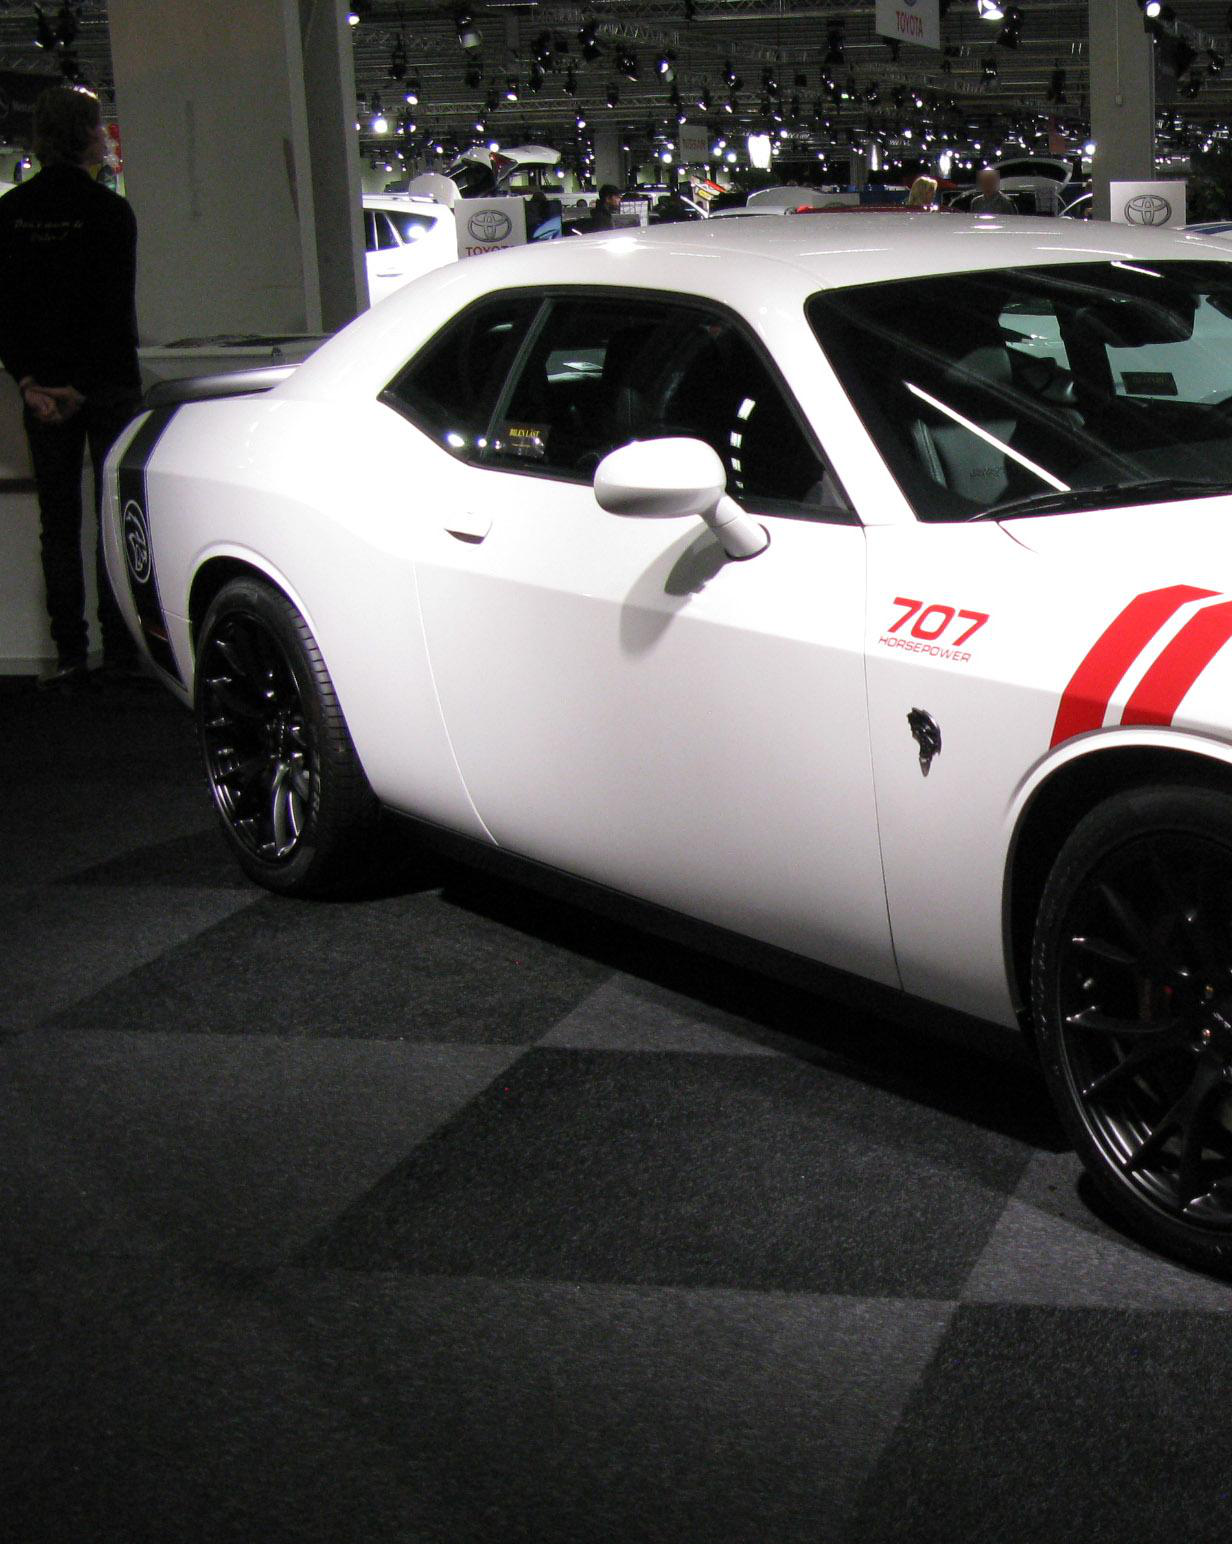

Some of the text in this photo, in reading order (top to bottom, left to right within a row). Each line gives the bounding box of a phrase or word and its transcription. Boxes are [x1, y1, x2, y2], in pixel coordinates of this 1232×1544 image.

[895, 10, 924, 39] TOYOTA
[465, 245, 515, 257] TOY
[887, 596, 990, 647] 707
[879, 635, 972, 662] HORSEPOWER
